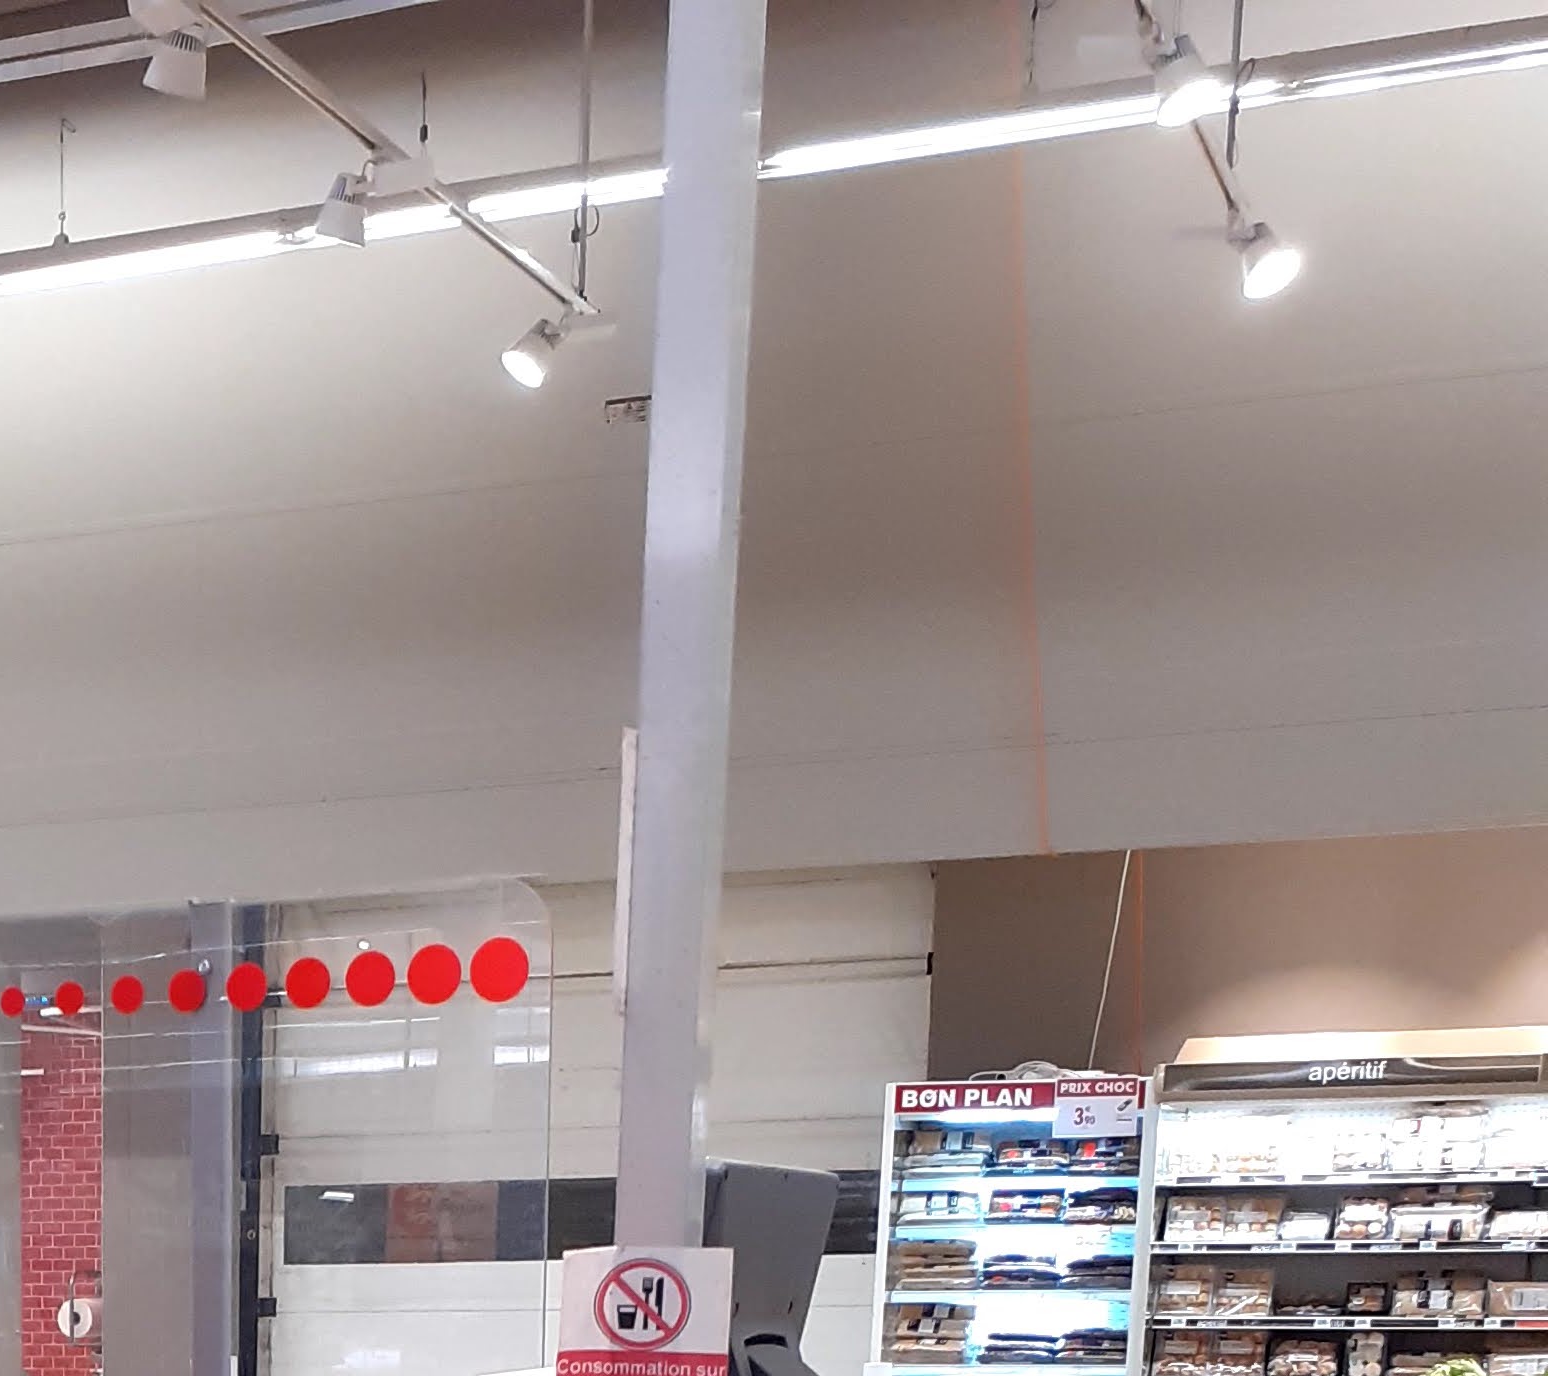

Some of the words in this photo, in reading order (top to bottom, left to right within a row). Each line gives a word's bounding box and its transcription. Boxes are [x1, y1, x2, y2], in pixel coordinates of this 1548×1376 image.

[1308, 1060, 1388, 1085] apéritif
[964, 1087, 1032, 1107] PLAN
[1060, 1082, 1091, 1094] PRIX
[1095, 1081, 1134, 1094] CHOC
